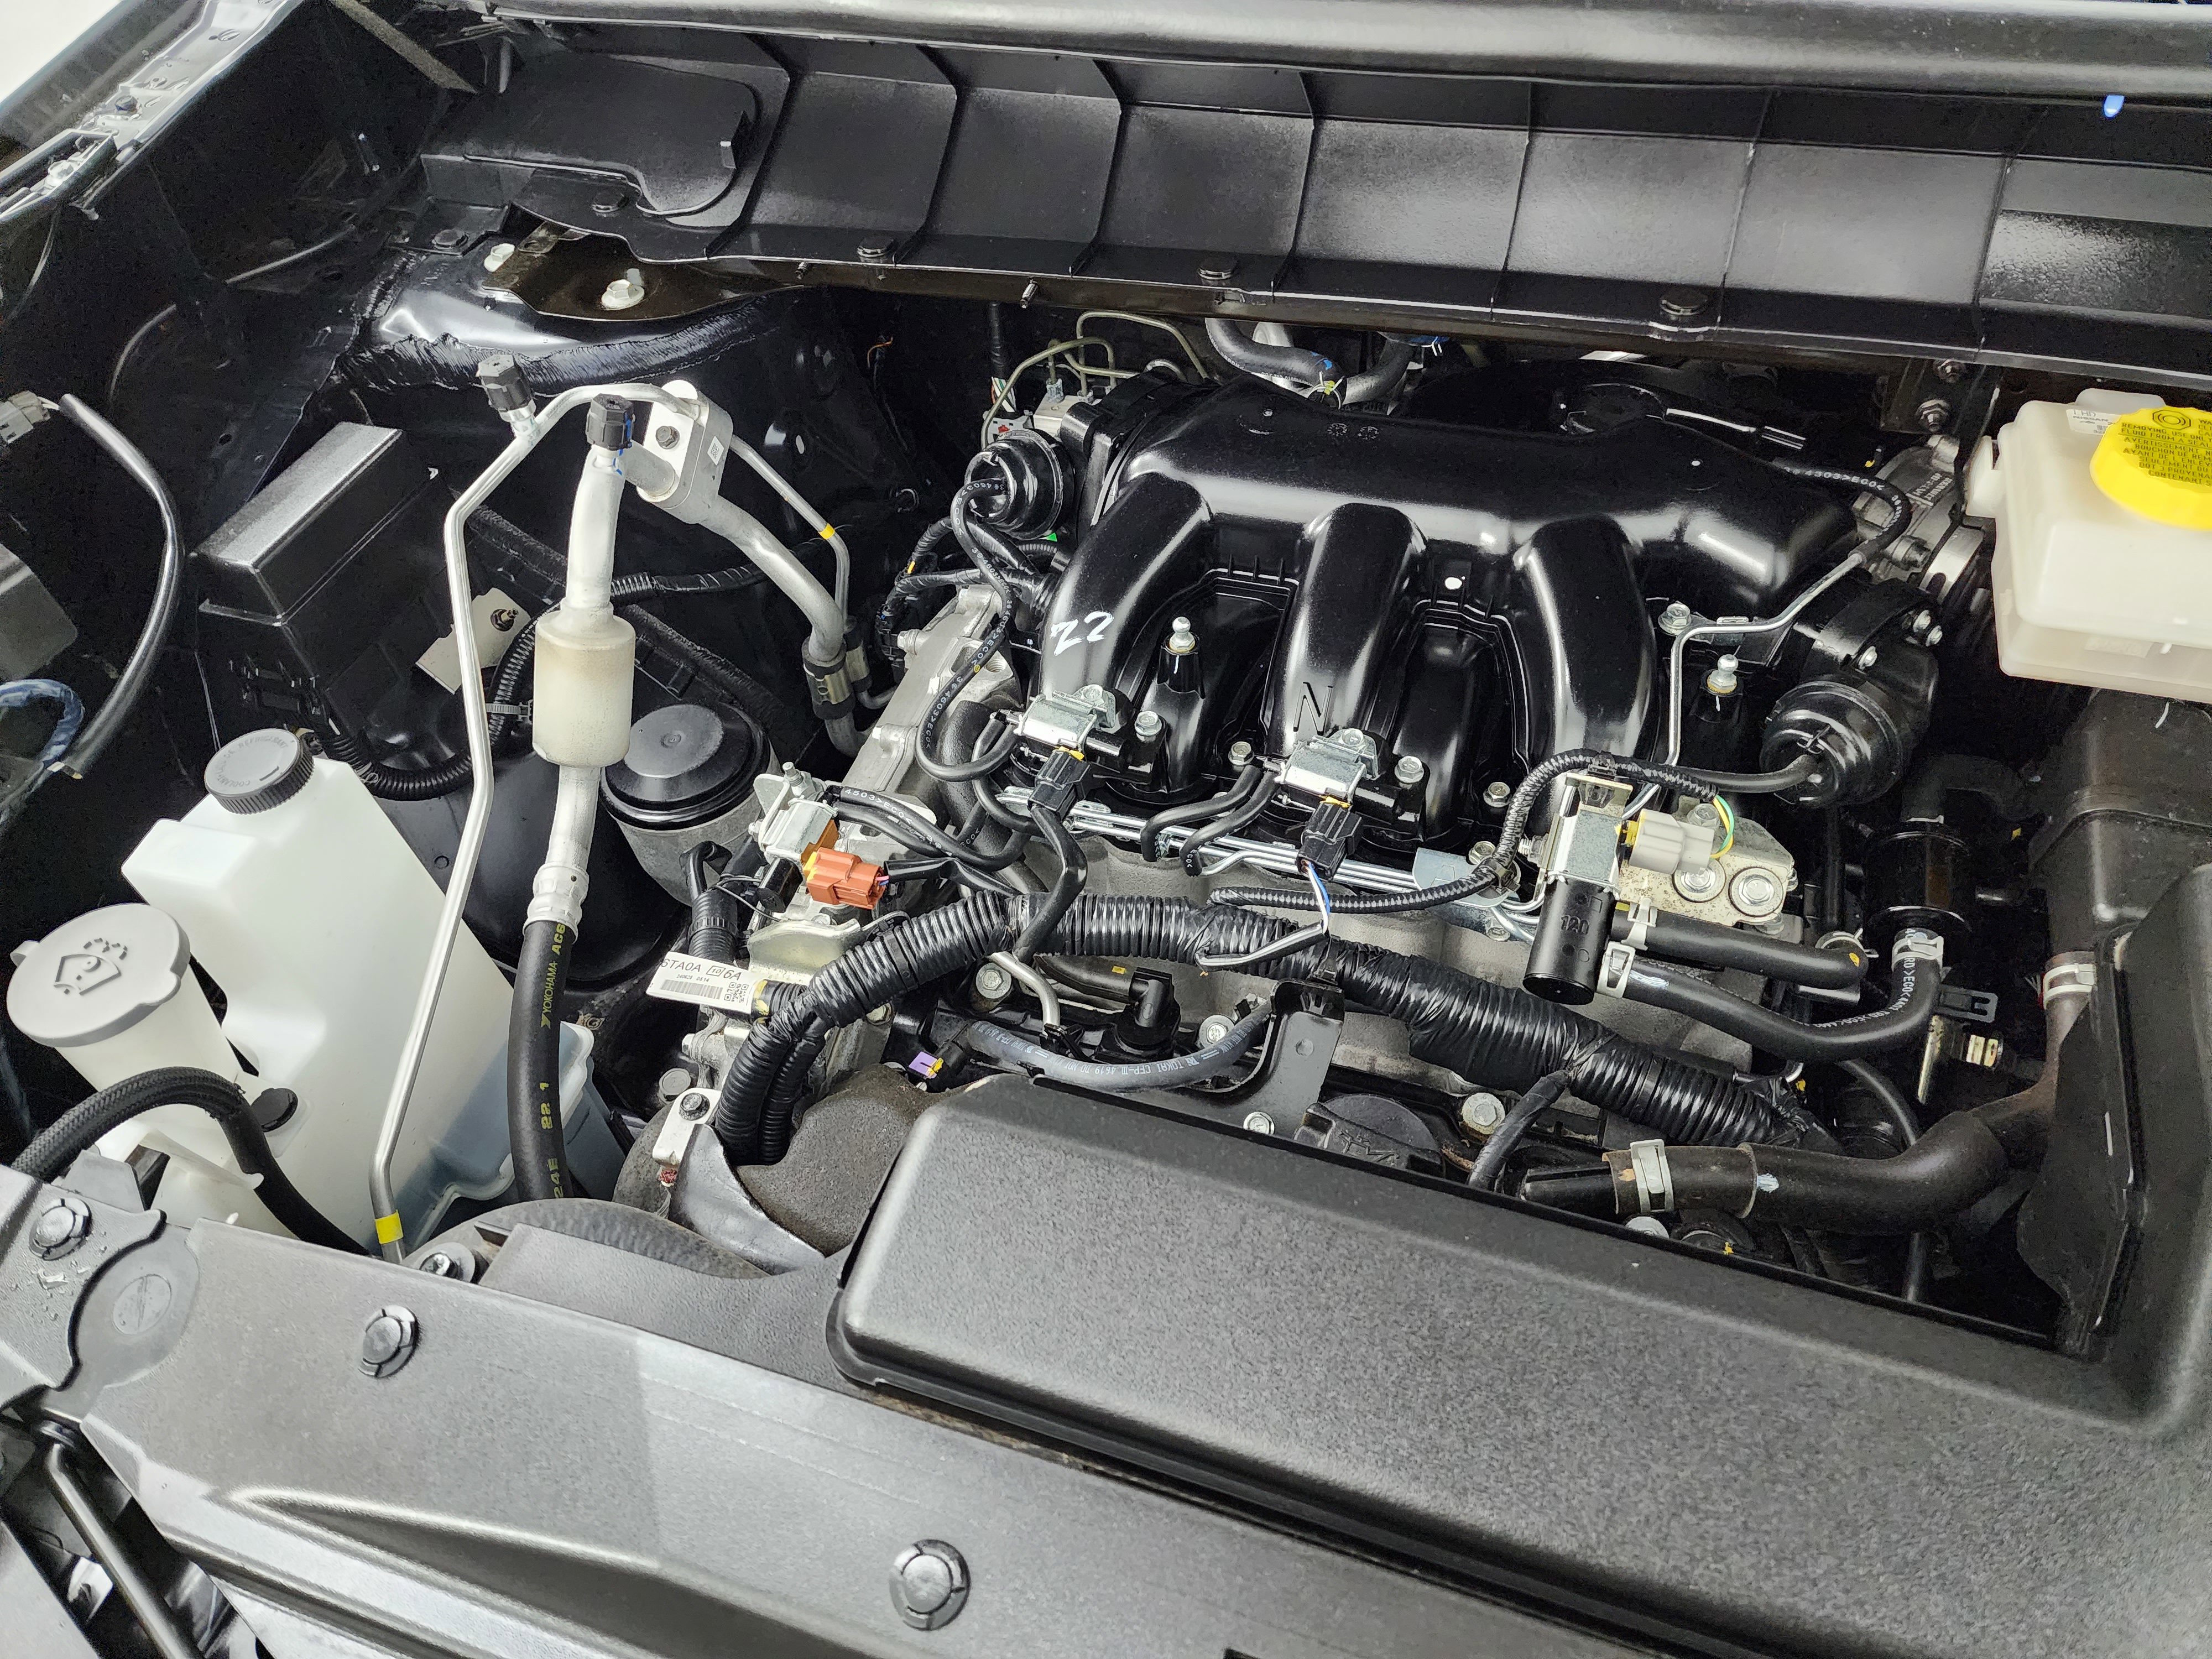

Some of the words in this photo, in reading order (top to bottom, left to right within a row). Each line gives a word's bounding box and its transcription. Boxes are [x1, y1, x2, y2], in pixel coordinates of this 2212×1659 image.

[2188, 439, 2210, 447] SEAL
[2192, 454, 2212, 462] REM
[723, 969, 742, 980] 6A
[542, 963, 557, 1013] YOKOHAMA
[1094, 1065, 1116, 1075] 4619
[1157, 1058, 1184, 1073] TOKAI
